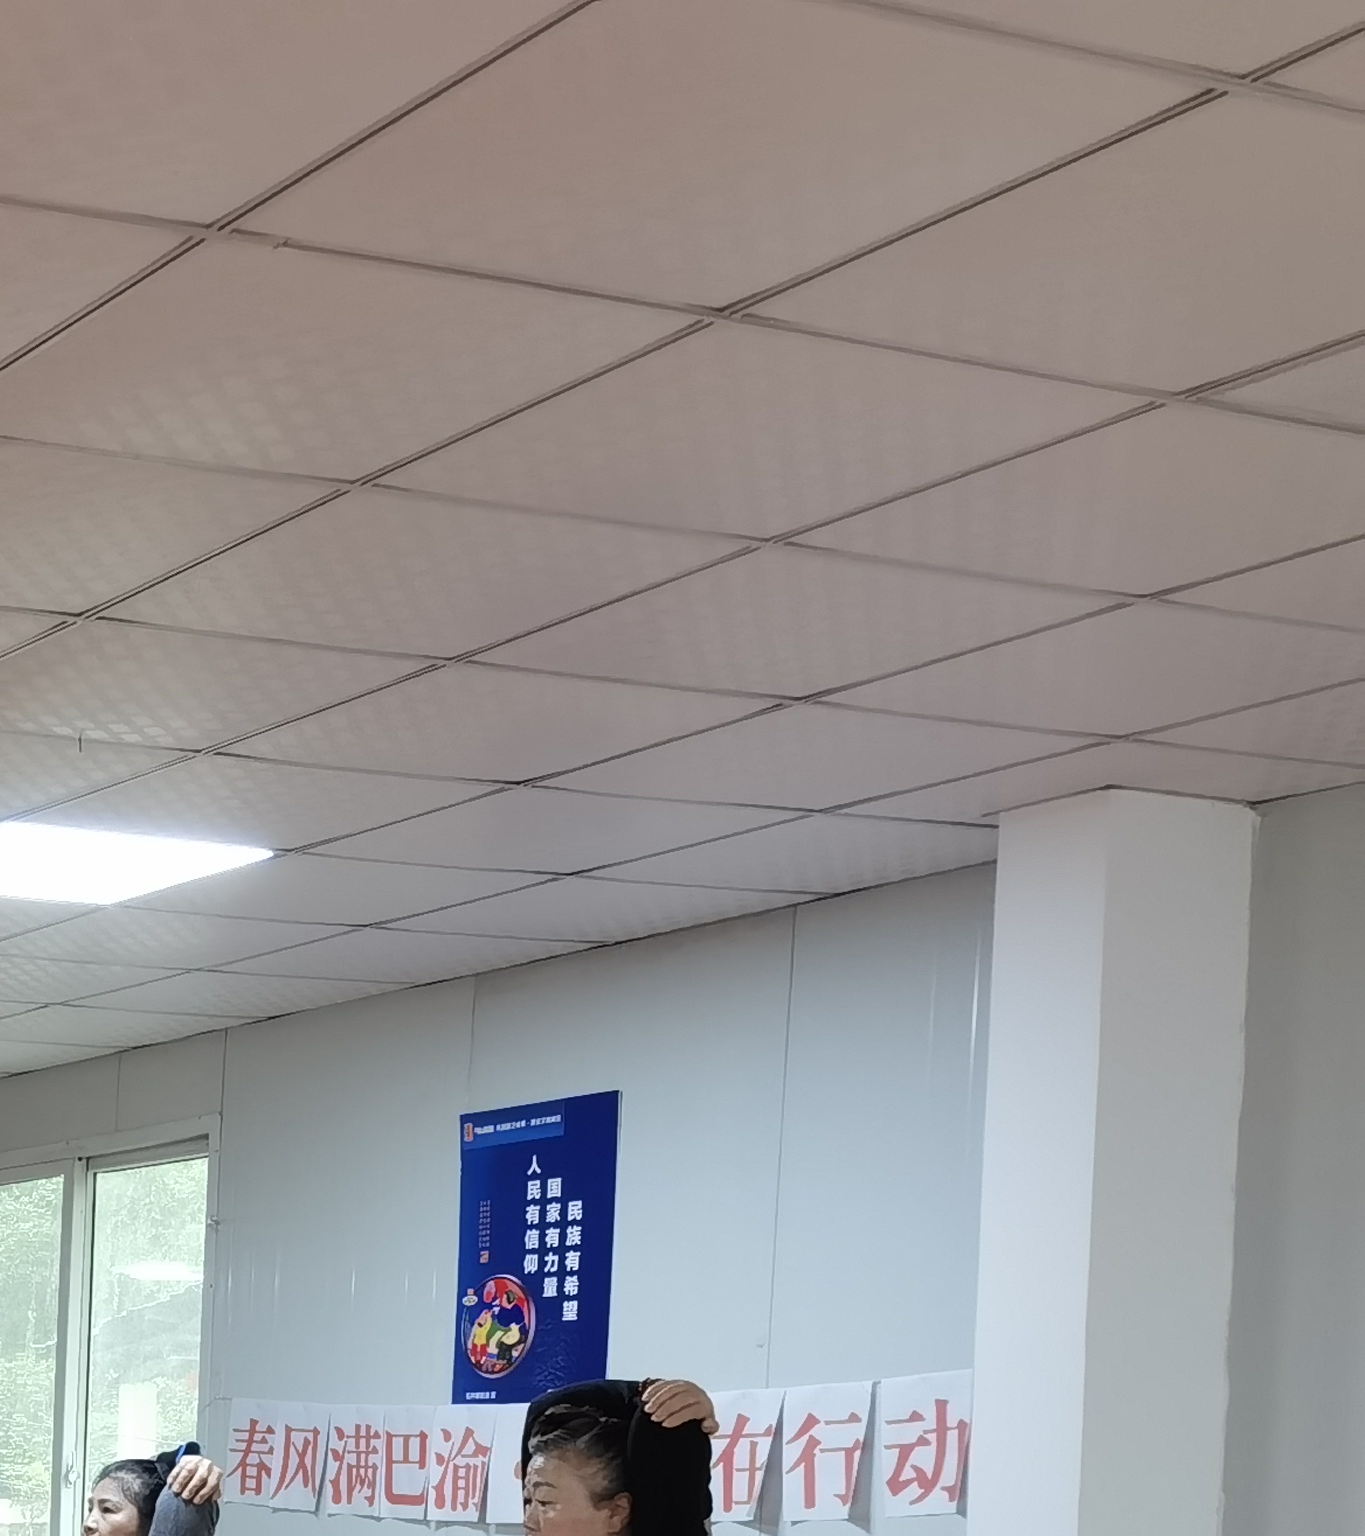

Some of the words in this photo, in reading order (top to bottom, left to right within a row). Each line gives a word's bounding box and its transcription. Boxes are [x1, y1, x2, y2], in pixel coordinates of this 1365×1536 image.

[523, 1154, 541, 1275] 人民有信仰
[542, 1177, 562, 1298] 国家有力量
[562, 1200, 583, 1322] 民族有希望
[225, 1417, 492, 1513] 春风满巴渝
[711, 1398, 971, 1513] 在行动
